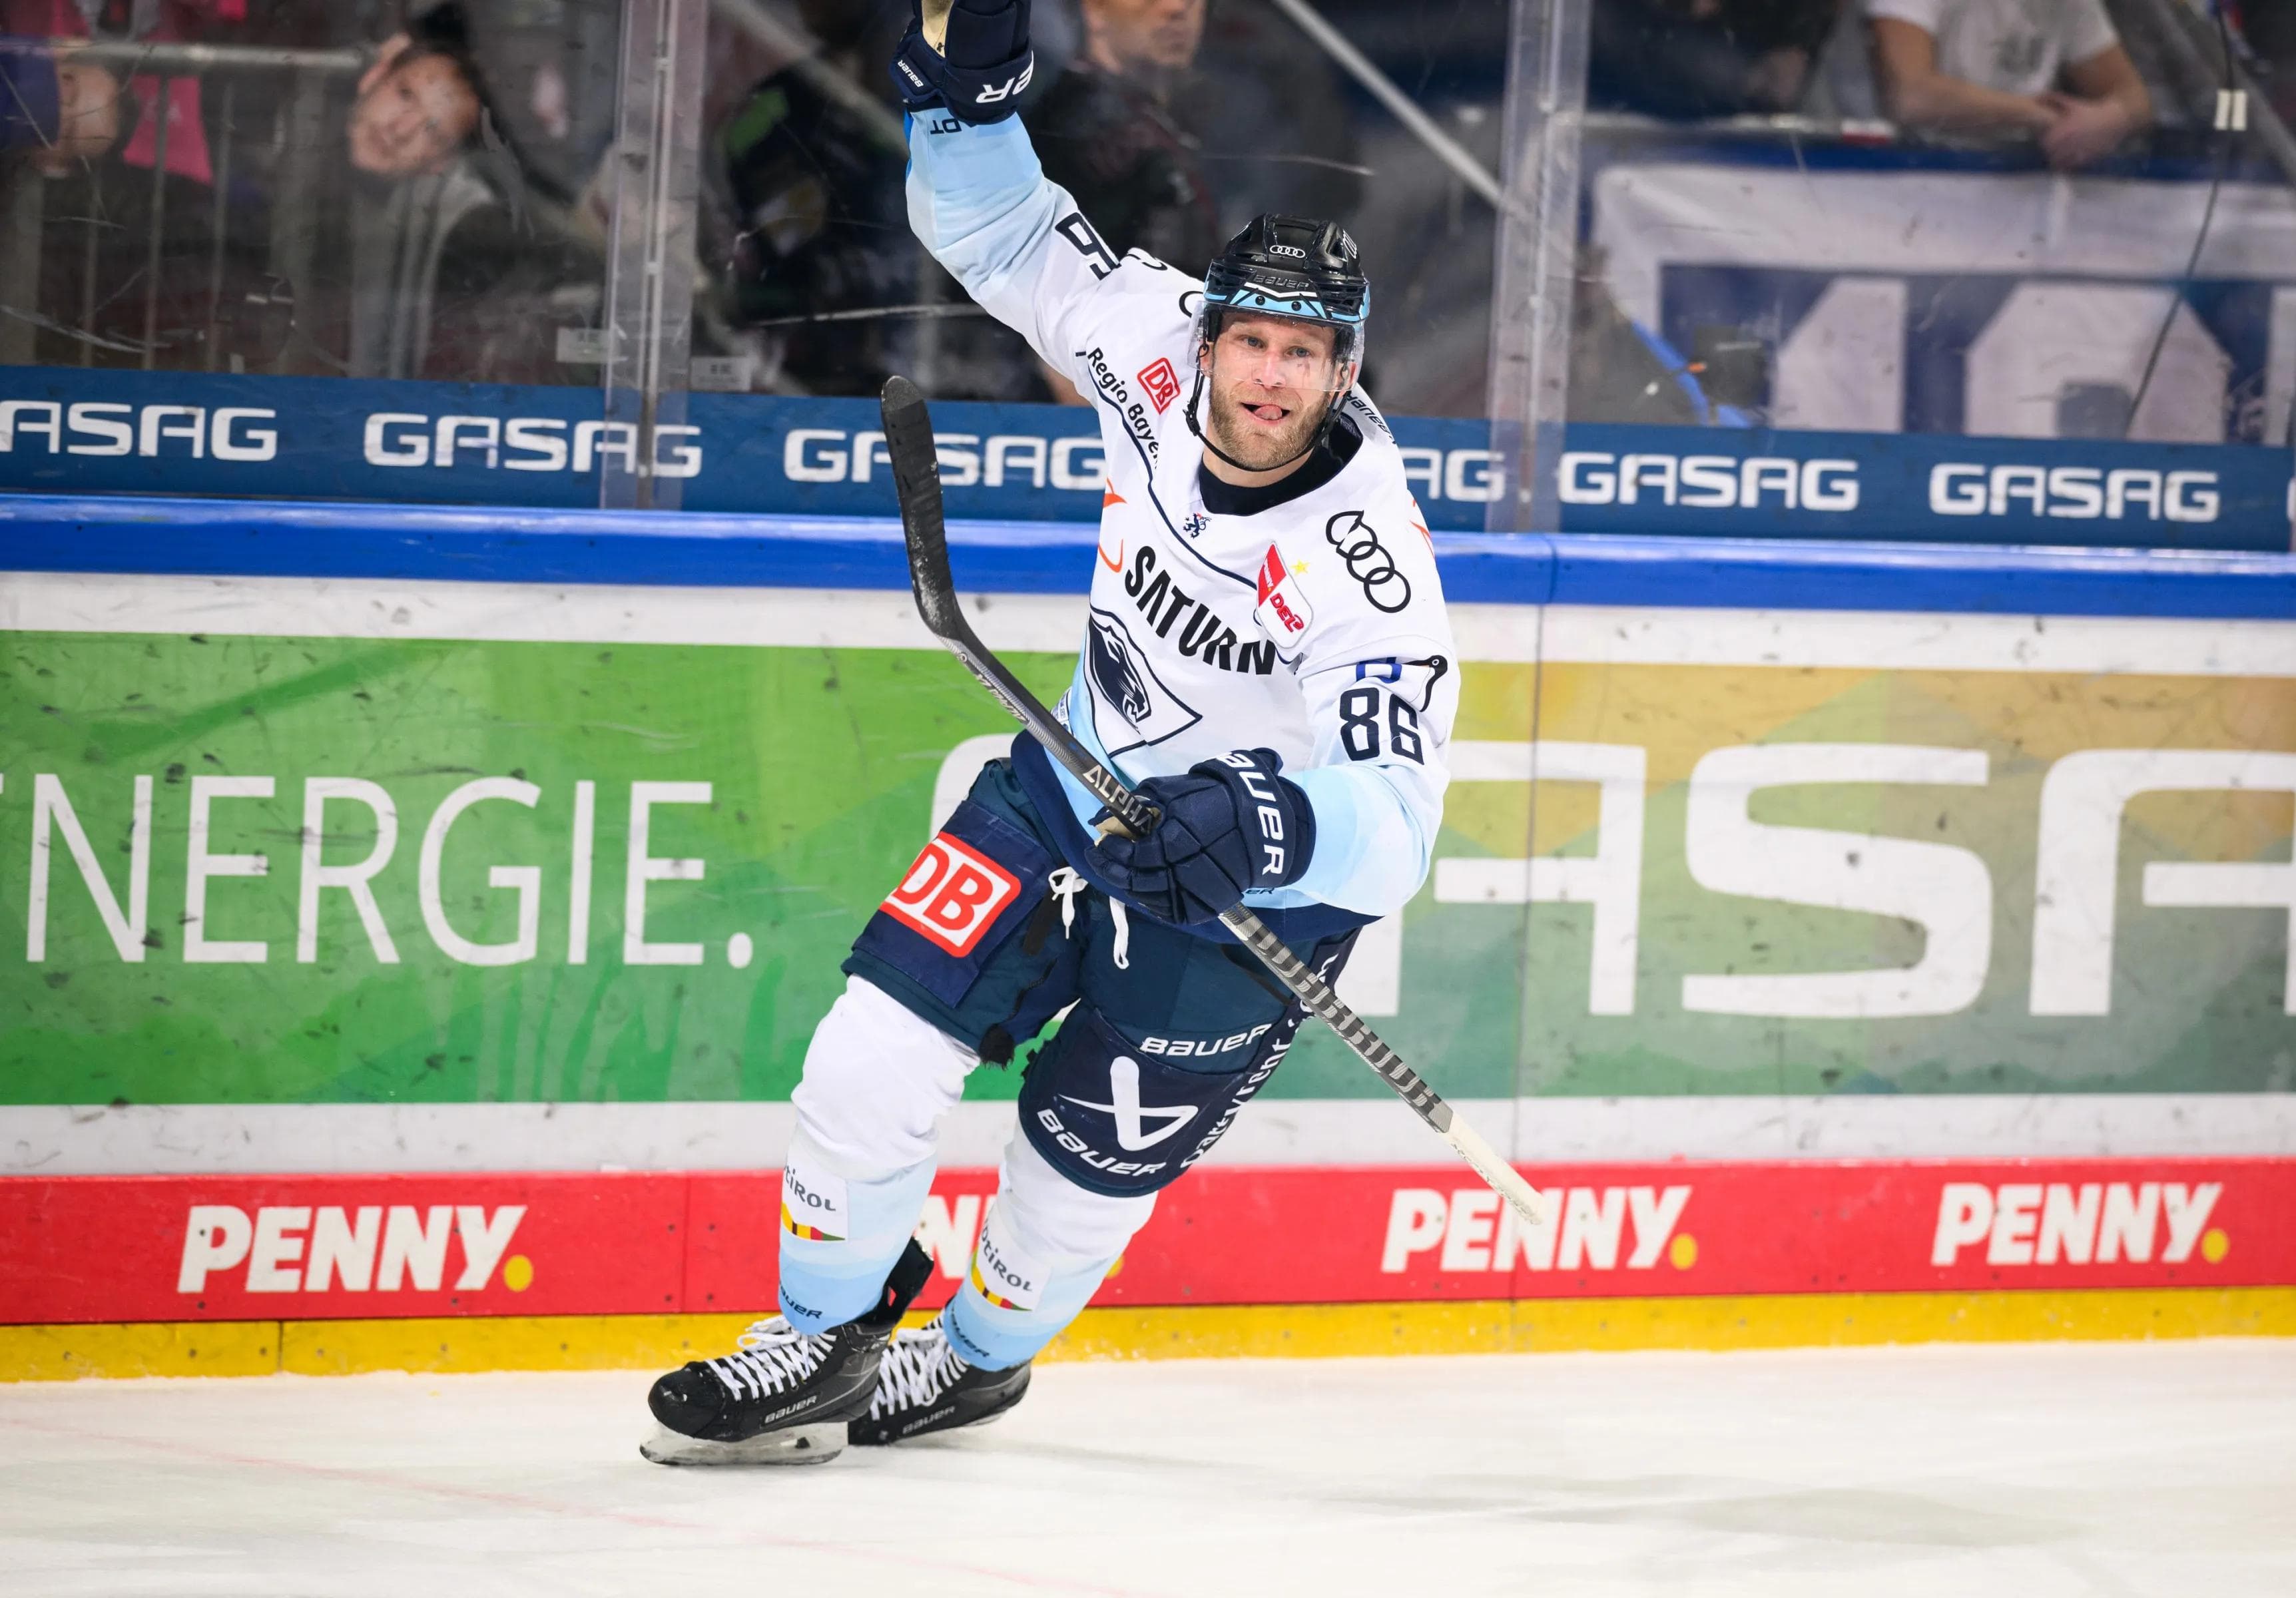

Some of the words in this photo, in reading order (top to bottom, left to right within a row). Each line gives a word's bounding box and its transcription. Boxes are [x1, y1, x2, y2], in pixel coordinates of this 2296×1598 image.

[897, 59, 924, 88] BAUER
[1254, 274, 1310, 291] BAUER
[0, 400, 278, 461] ASAG
[1087, 347, 1128, 403] Regio
[1127, 403, 1160, 469] Baye
[364, 412, 703, 479] GASAG
[1558, 452, 1859, 511] GASAG
[1929, 463, 2219, 523] GASAG
[1125, 545, 1276, 675] SATURN
[1340, 687, 1425, 766] 86
[1083, 764, 1154, 833] ALPHA
[0, 773, 754, 969] NERGIE.
[892, 841, 994, 932] DB
[1139, 1023, 1273, 1057] BAUER
[1037, 1108, 1167, 1177] BAUER
[177, 1204, 533, 1293] PENNY.
[1380, 1185, 1698, 1273] PENNY.
[1930, 1182, 2230, 1266] PENNY.
[780, 1281, 823, 1320] AUER
[764, 1395, 818, 1424] BAUER
[902, 1406, 956, 1435] BAUER
